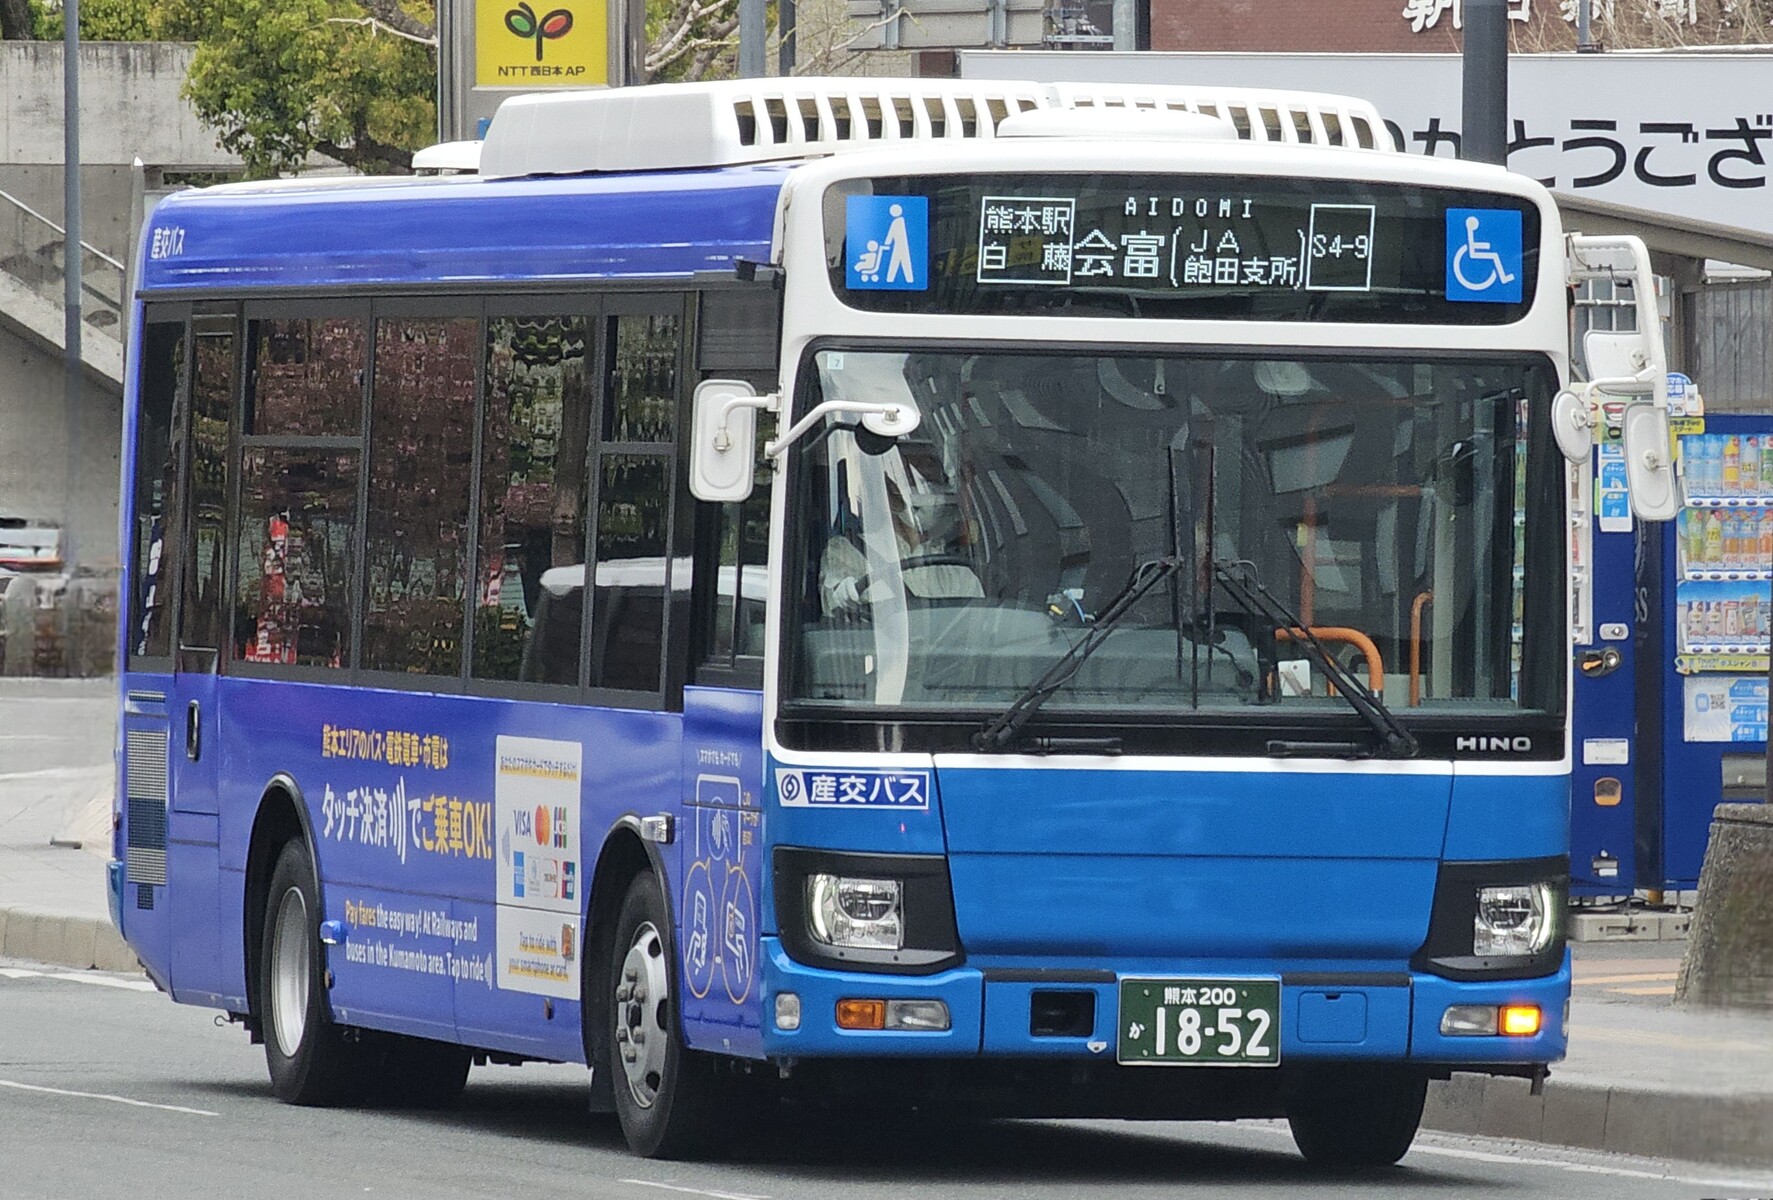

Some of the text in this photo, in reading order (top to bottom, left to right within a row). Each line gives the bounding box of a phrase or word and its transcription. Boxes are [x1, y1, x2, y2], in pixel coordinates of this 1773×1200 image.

[986, 206, 1070, 235] 熊本駅
[1124, 197, 1252, 218] AIDOMI
[151, 226, 185, 259] 産交バス
[1074, 229, 1164, 278] 会富
[1312, 233, 1369, 258] S4-9
[1456, 736, 1532, 752] HINO
[811, 775, 923, 803] 産交バス
[513, 810, 531, 837] VISA
[345, 899, 478, 946] Pay fares the easy way! At Railways and
[345, 937, 484, 984] buses in the Kumamoto area. Tap to ride
[1128, 1006, 1271, 1056] か 18-52
